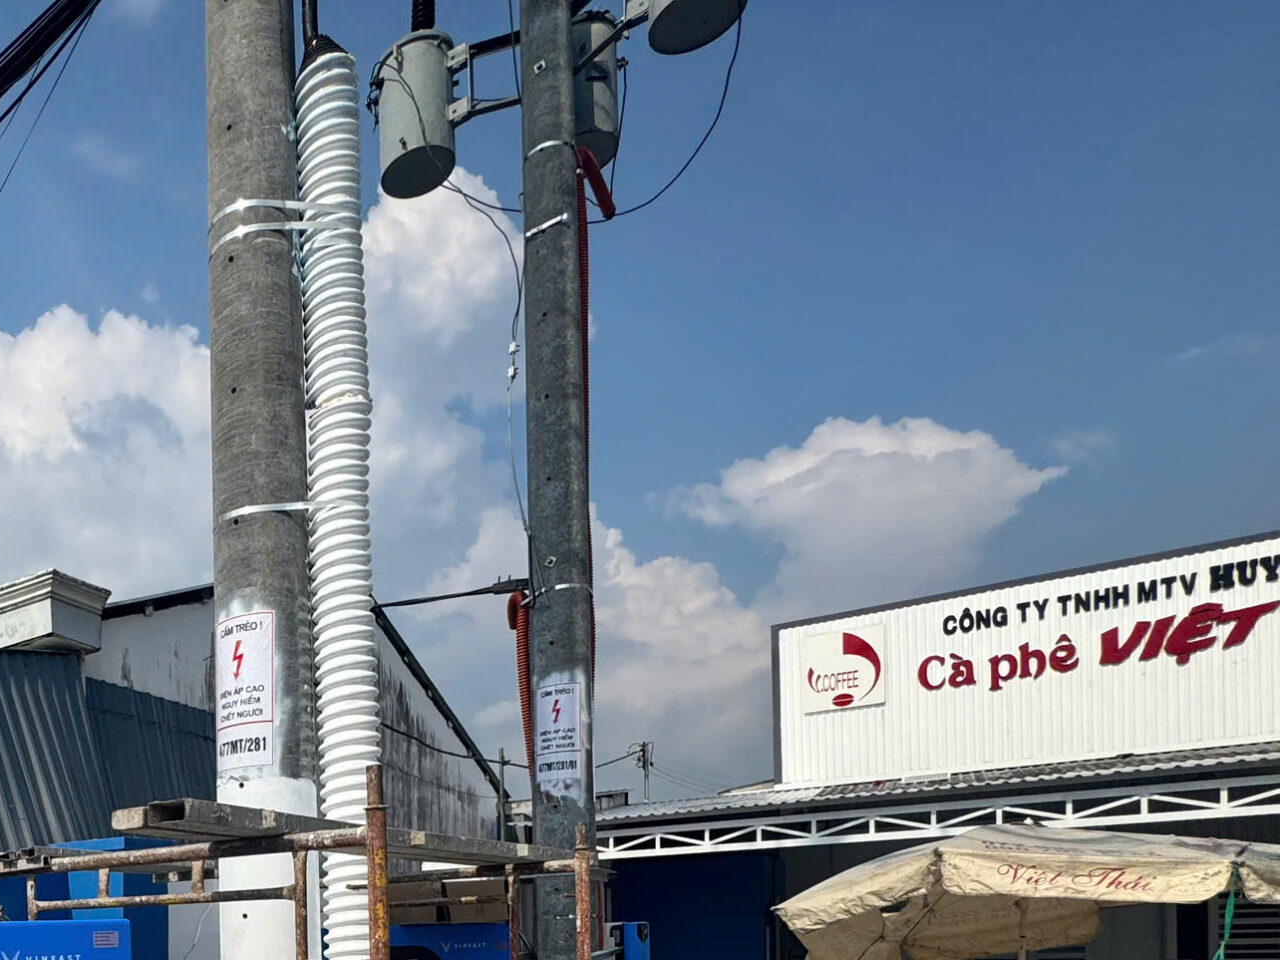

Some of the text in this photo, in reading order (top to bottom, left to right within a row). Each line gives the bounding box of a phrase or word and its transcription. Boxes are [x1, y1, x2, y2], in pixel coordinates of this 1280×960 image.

[943, 607, 1008, 635] CÔNG
[1017, 598, 1049, 623] TY
[1057, 584, 1130, 616] TNHH
[1137, 572, 1197, 604] MTV
[918, 600, 1280, 691] Cà phê VIỆT
[245, 684, 265, 693] CAO
